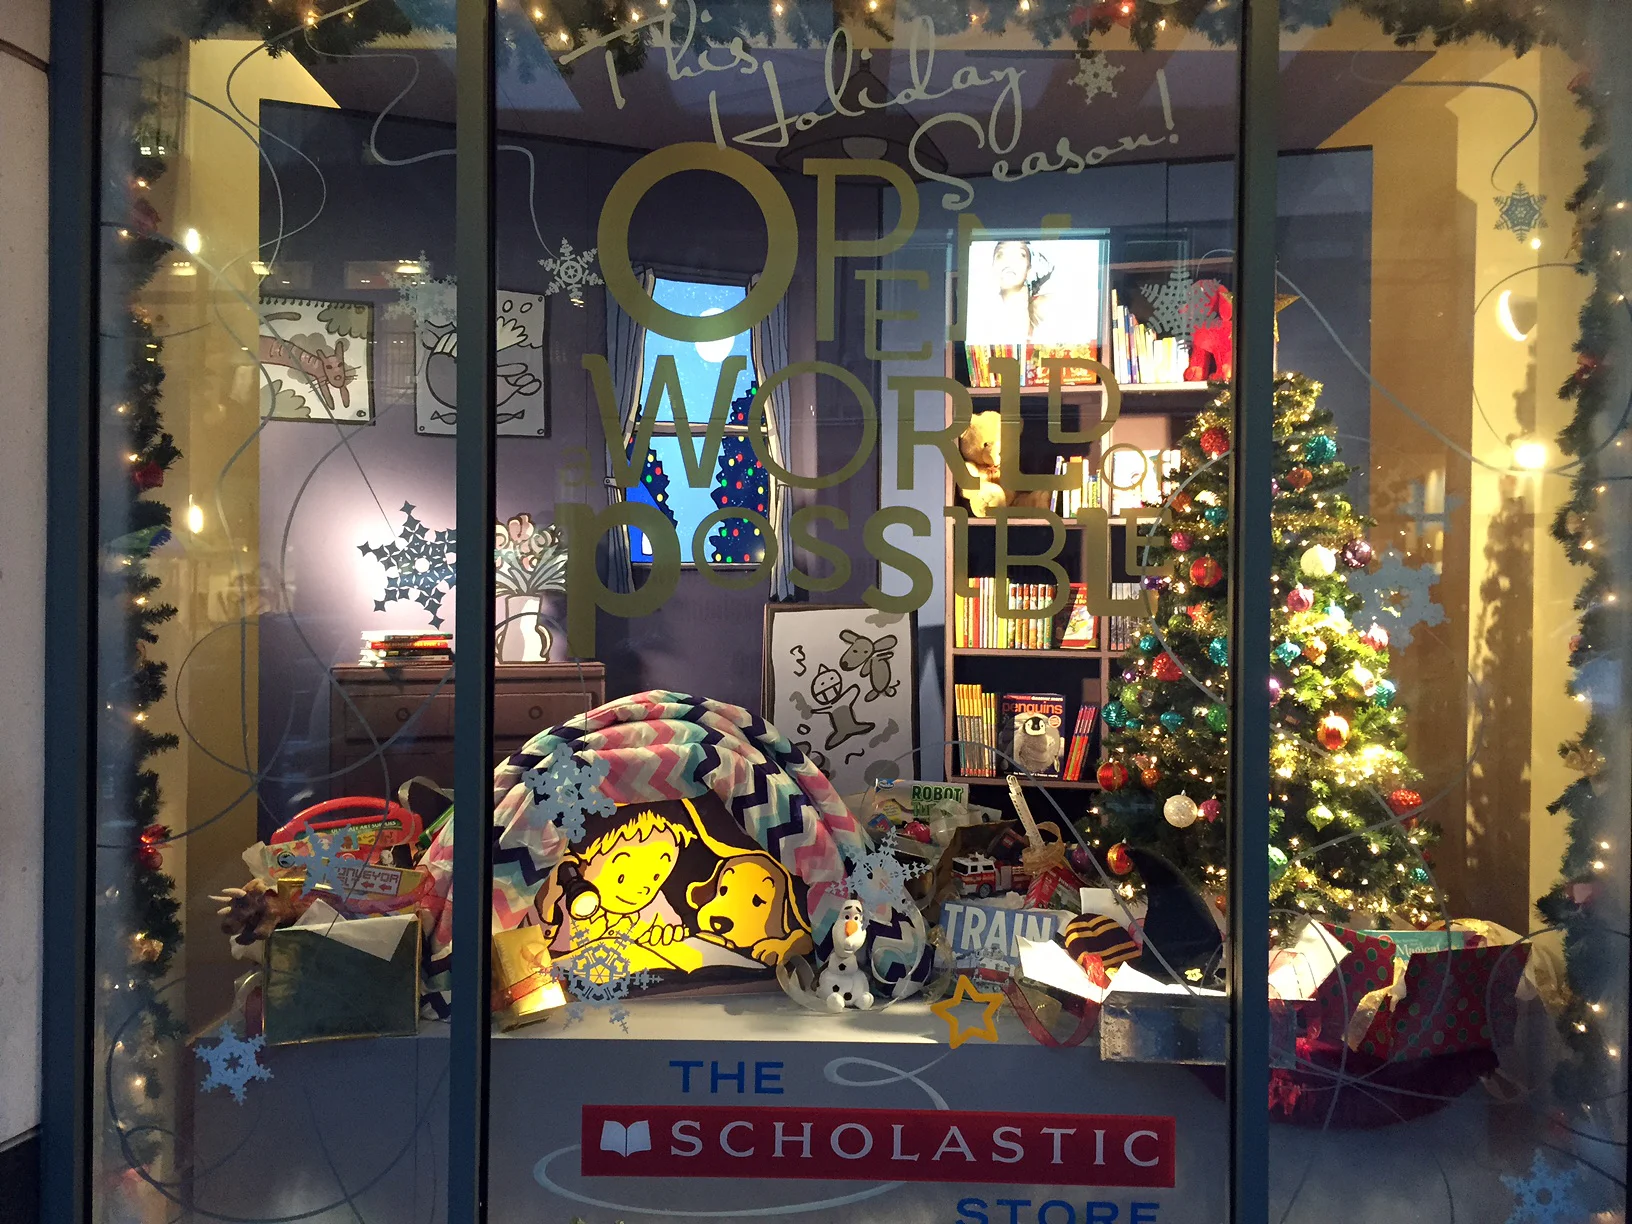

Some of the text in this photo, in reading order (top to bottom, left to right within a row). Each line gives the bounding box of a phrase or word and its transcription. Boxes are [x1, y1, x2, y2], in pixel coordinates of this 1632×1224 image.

[558, 0, 758, 110] This
[708, 15, 1026, 154] Holiday
[909, 69, 1179, 211] Season!
[582, 354, 1121, 491] WORLD
[912, 785, 964, 804] ROBOT
[335, 867, 399, 884] ONVEYOR
[944, 903, 1052, 957] TRAIN
[669, 1061, 784, 1094] THE
[671, 1120, 1160, 1168] SCHOLASTIC
[955, 1197, 1160, 1224] STORE
